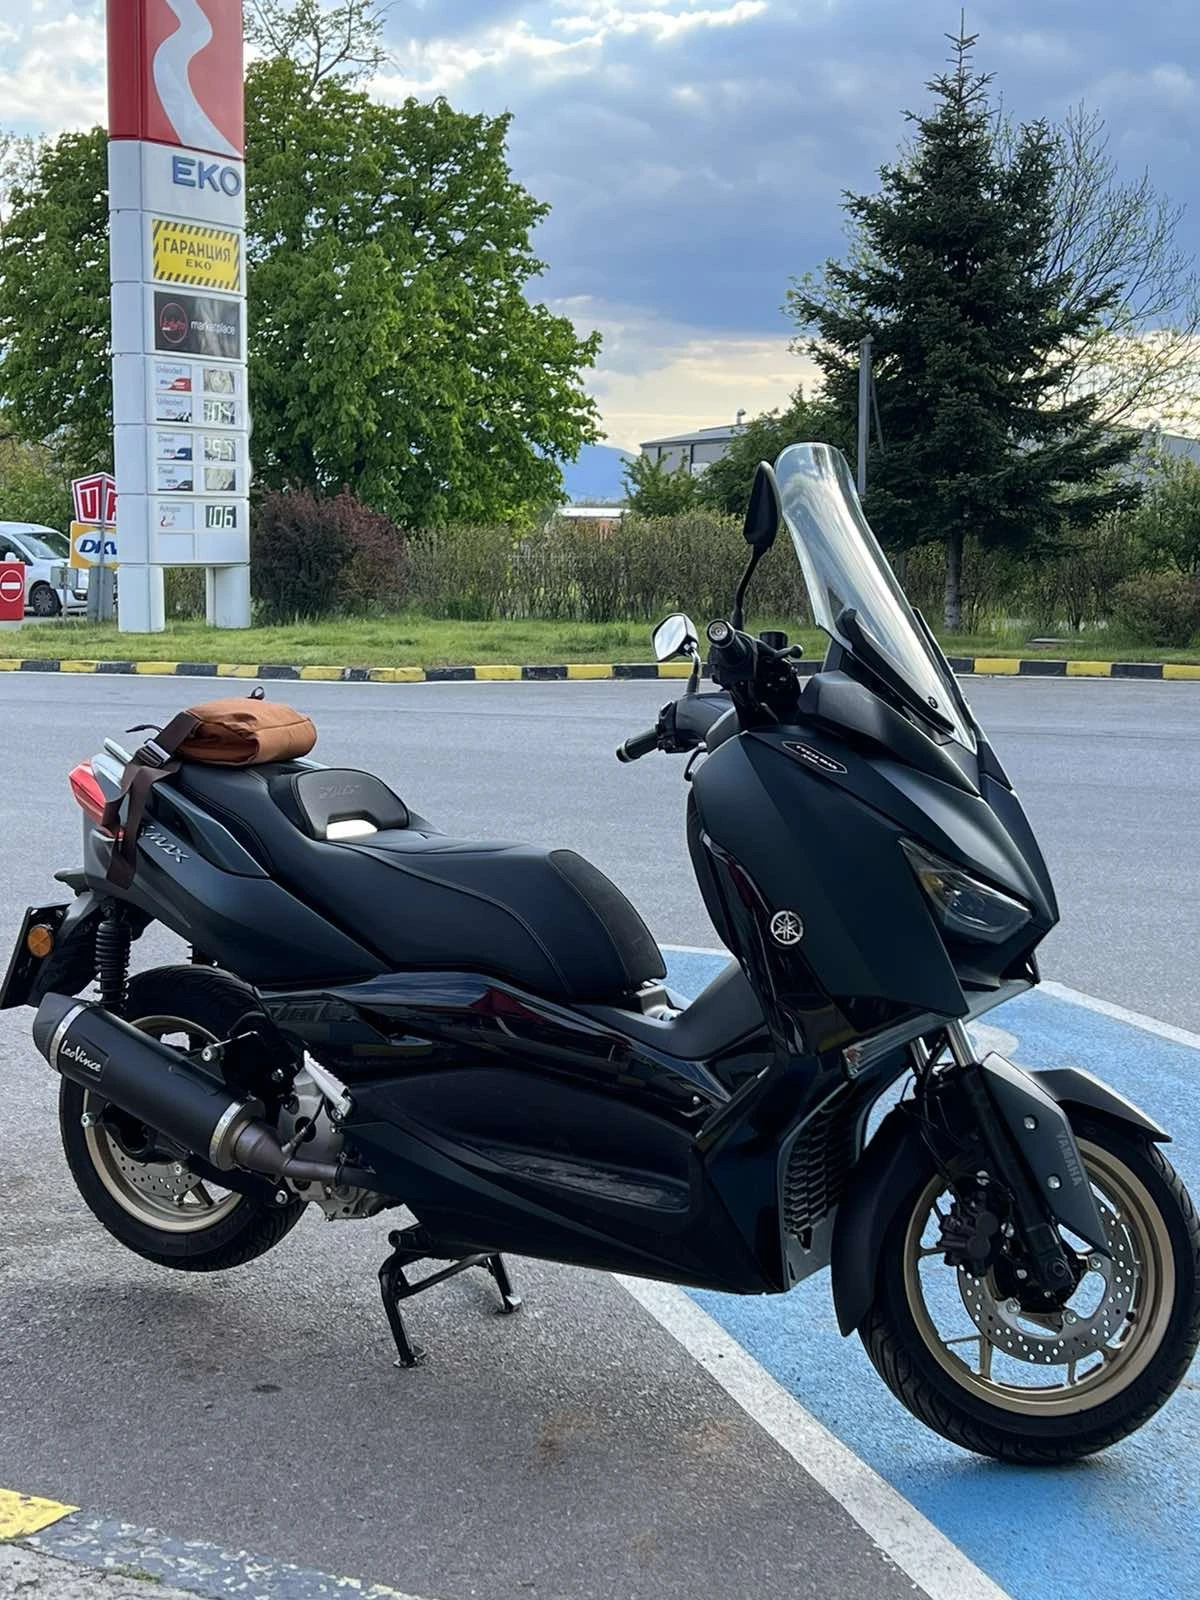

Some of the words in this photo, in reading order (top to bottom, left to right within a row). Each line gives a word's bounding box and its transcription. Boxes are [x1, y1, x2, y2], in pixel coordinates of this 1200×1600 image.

[172, 155, 241, 197] EKO
[163, 236, 231, 262] ГАРАНЦИЯ
[208, 506, 234, 528] 106
[60, 1039, 102, 1072] LeoVince
[1055, 1130, 1082, 1187] YAMAHA
